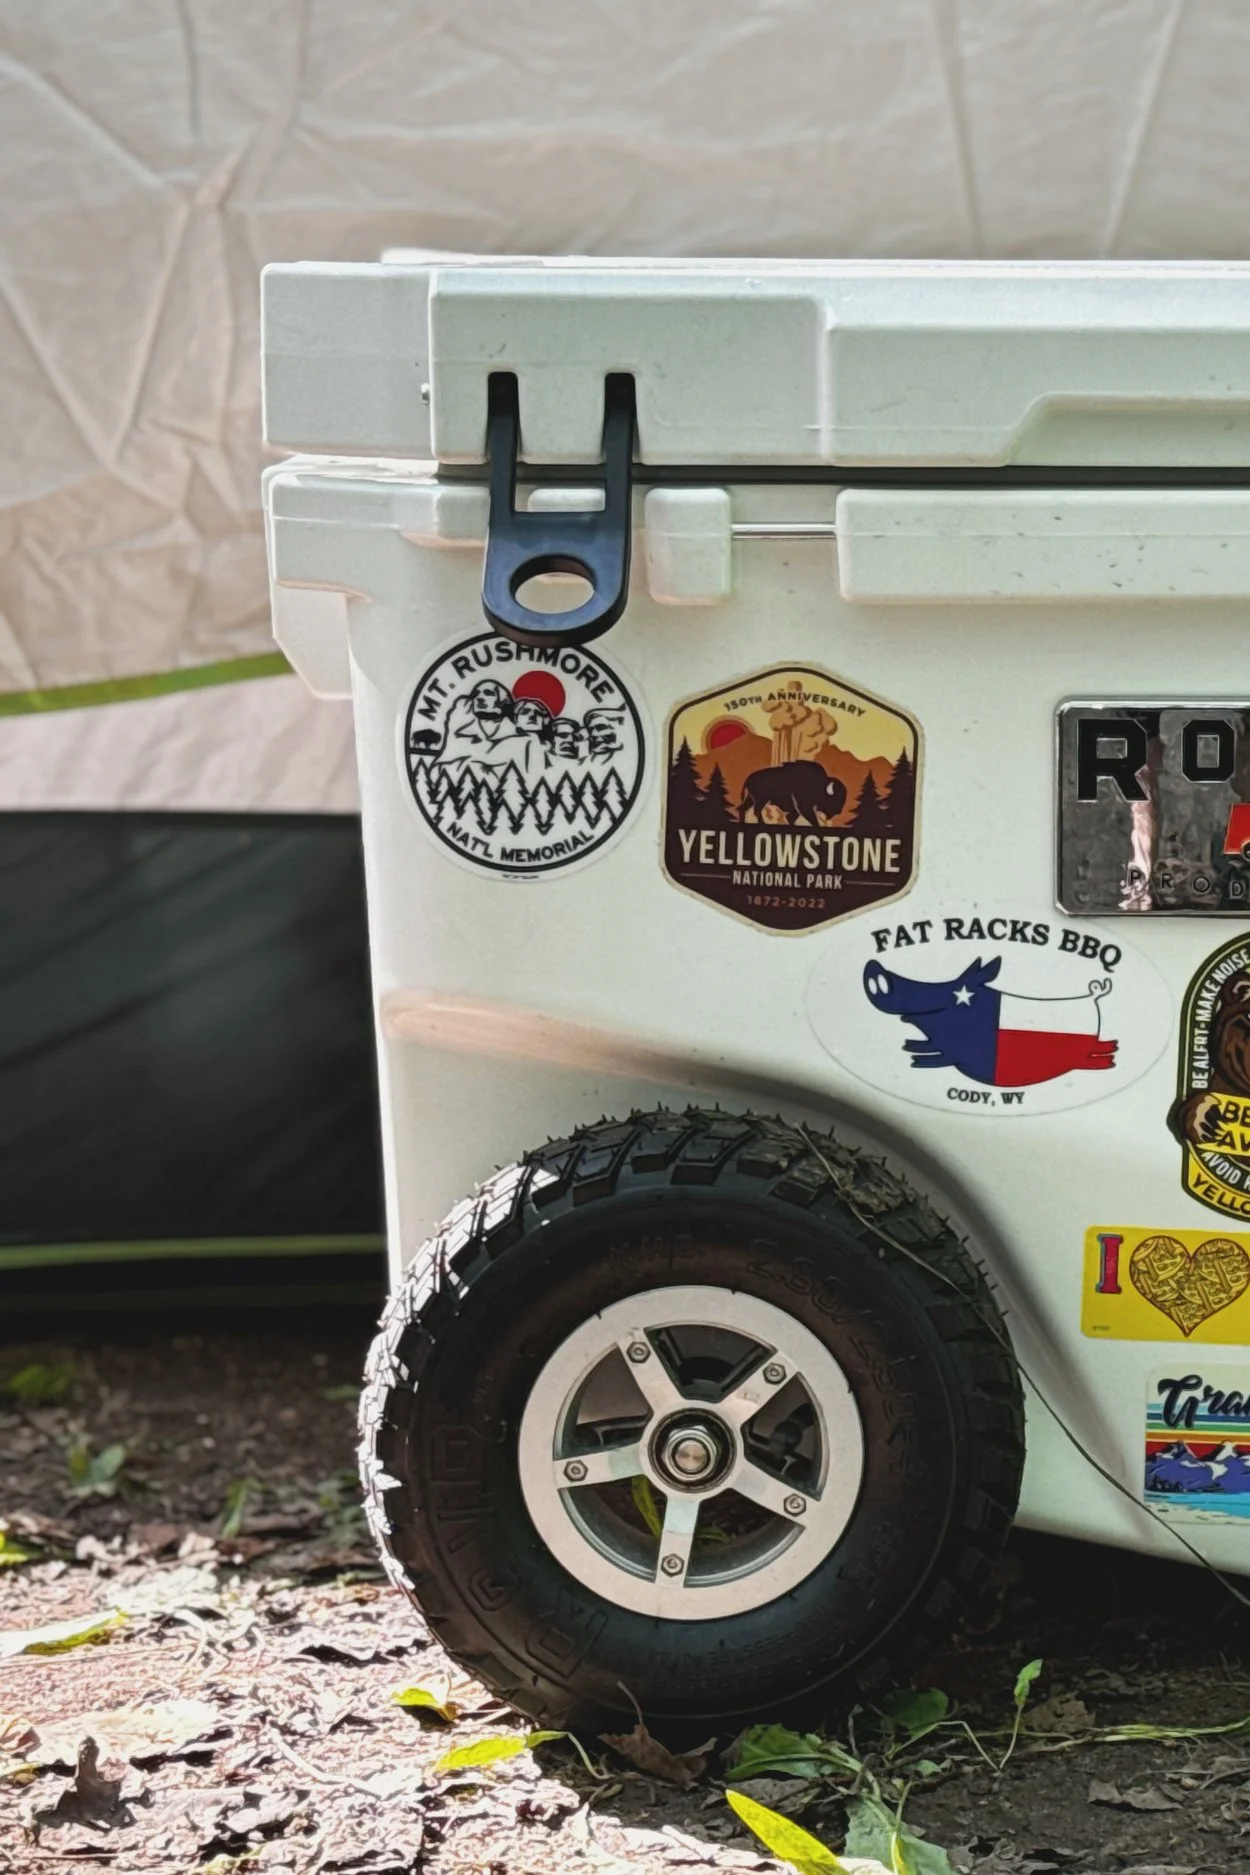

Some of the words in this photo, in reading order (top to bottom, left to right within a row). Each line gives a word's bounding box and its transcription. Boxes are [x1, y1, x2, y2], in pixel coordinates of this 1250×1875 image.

[418, 678, 456, 721] MT.
[451, 640, 615, 703] RUSHMORE
[724, 695, 763, 712] 150TH
[767, 690, 867, 717] ANNIVERSARY
[446, 822, 494, 858] NAT'L
[500, 830, 595, 863] MEMORIAL
[678, 828, 902, 873] YELLOWSTONE
[732, 870, 801, 889] NATIONAL
[806, 875, 843, 890] PARK
[746, 895, 827, 909] 1872-2022
[871, 919, 934, 953] FAT
[944, 917, 1050, 946] RACKS
[1057, 928, 1123, 973] BBQ
[1211, 949, 1250, 981] NOISE
[1195, 980, 1221, 1022] MAKE
[947, 1087, 996, 1106] CODY,
[1000, 1091, 1026, 1104] WY
[1192, 1070, 1209, 1089] BE
[1201, 1151, 1241, 1185] AVOID
[1095, 1233, 1125, 1294] I
